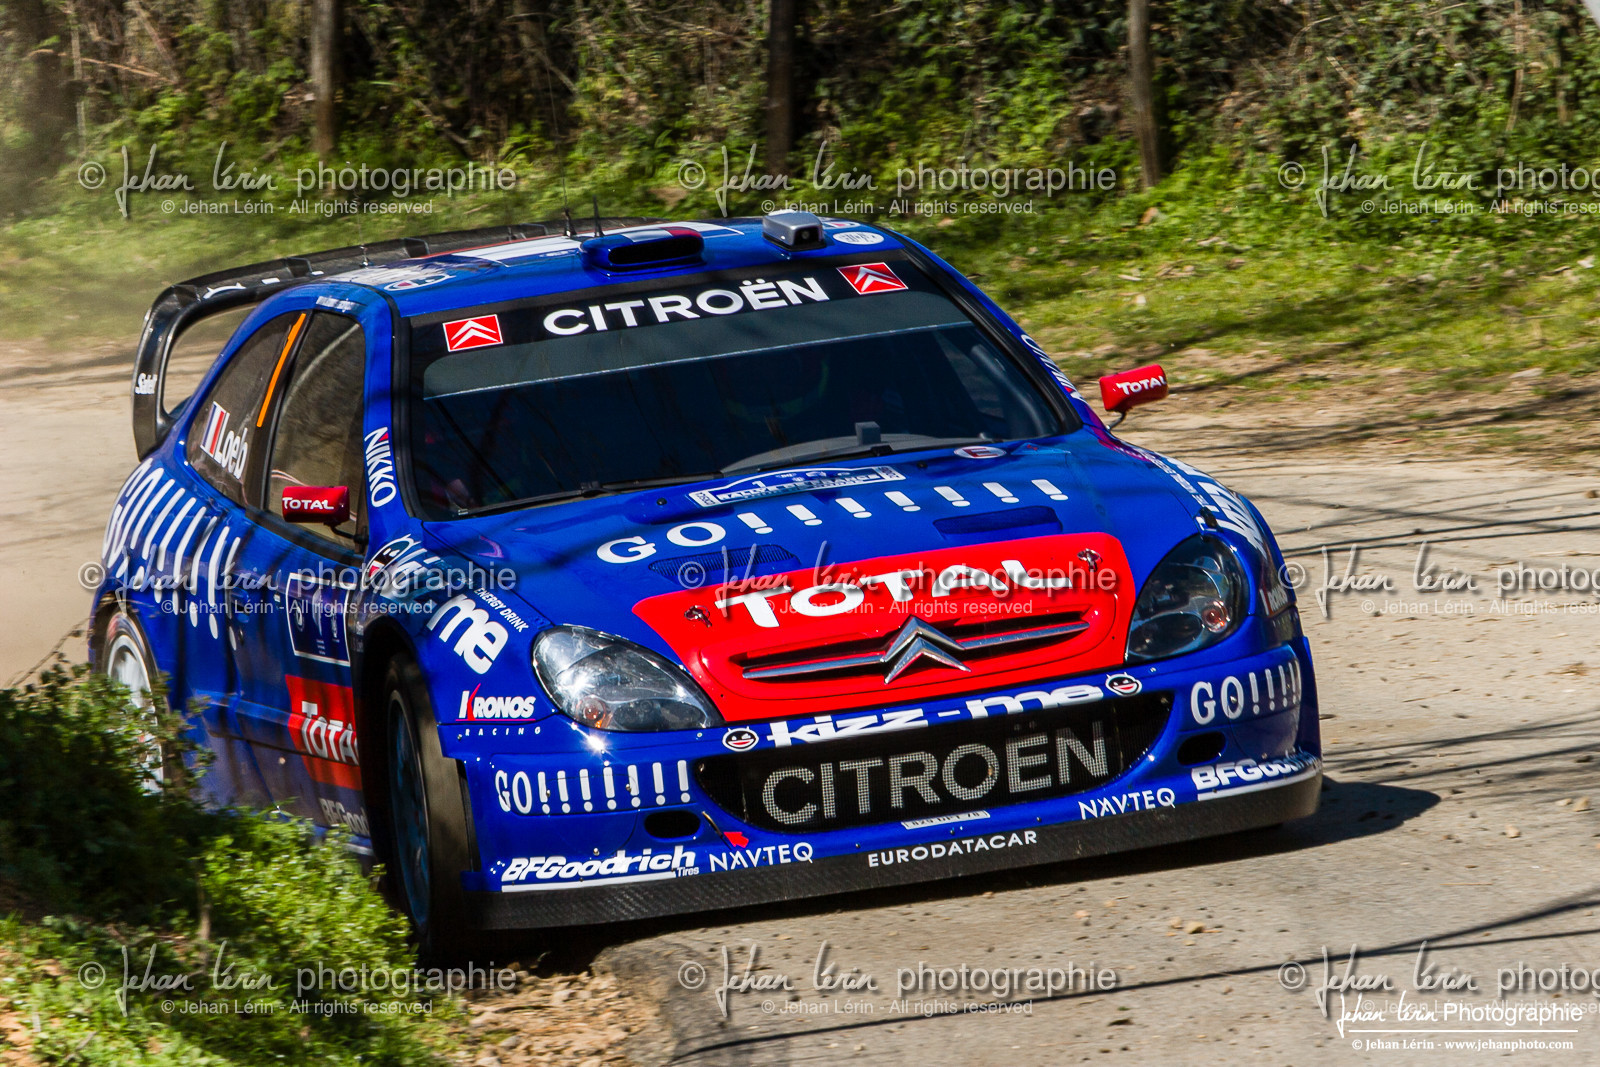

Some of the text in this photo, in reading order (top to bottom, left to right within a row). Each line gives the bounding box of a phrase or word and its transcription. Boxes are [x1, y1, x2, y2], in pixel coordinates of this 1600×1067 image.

[543, 278, 830, 335] CITROËN
[1116, 375, 1166, 395] TOTAL
[213, 412, 248, 480] Loeb
[364, 427, 397, 507] NIKKO
[282, 497, 334, 510] TOTAL
[474, 587, 529, 633] ENERGY DRINK
[714, 560, 1072, 628] TOTAL
[459, 683, 536, 720] KRONOS
[301, 700, 359, 765] TOTA
[465, 726, 541, 736] RACING
[762, 720, 1109, 825] CITROËN
[1078, 787, 1176, 820] NAVTEQ
[501, 845, 696, 882] BFGoodrich
[709, 842, 814, 872] NAVTEQ
[868, 831, 1038, 867] EURODATACAR
[677, 866, 699, 877] Tires
